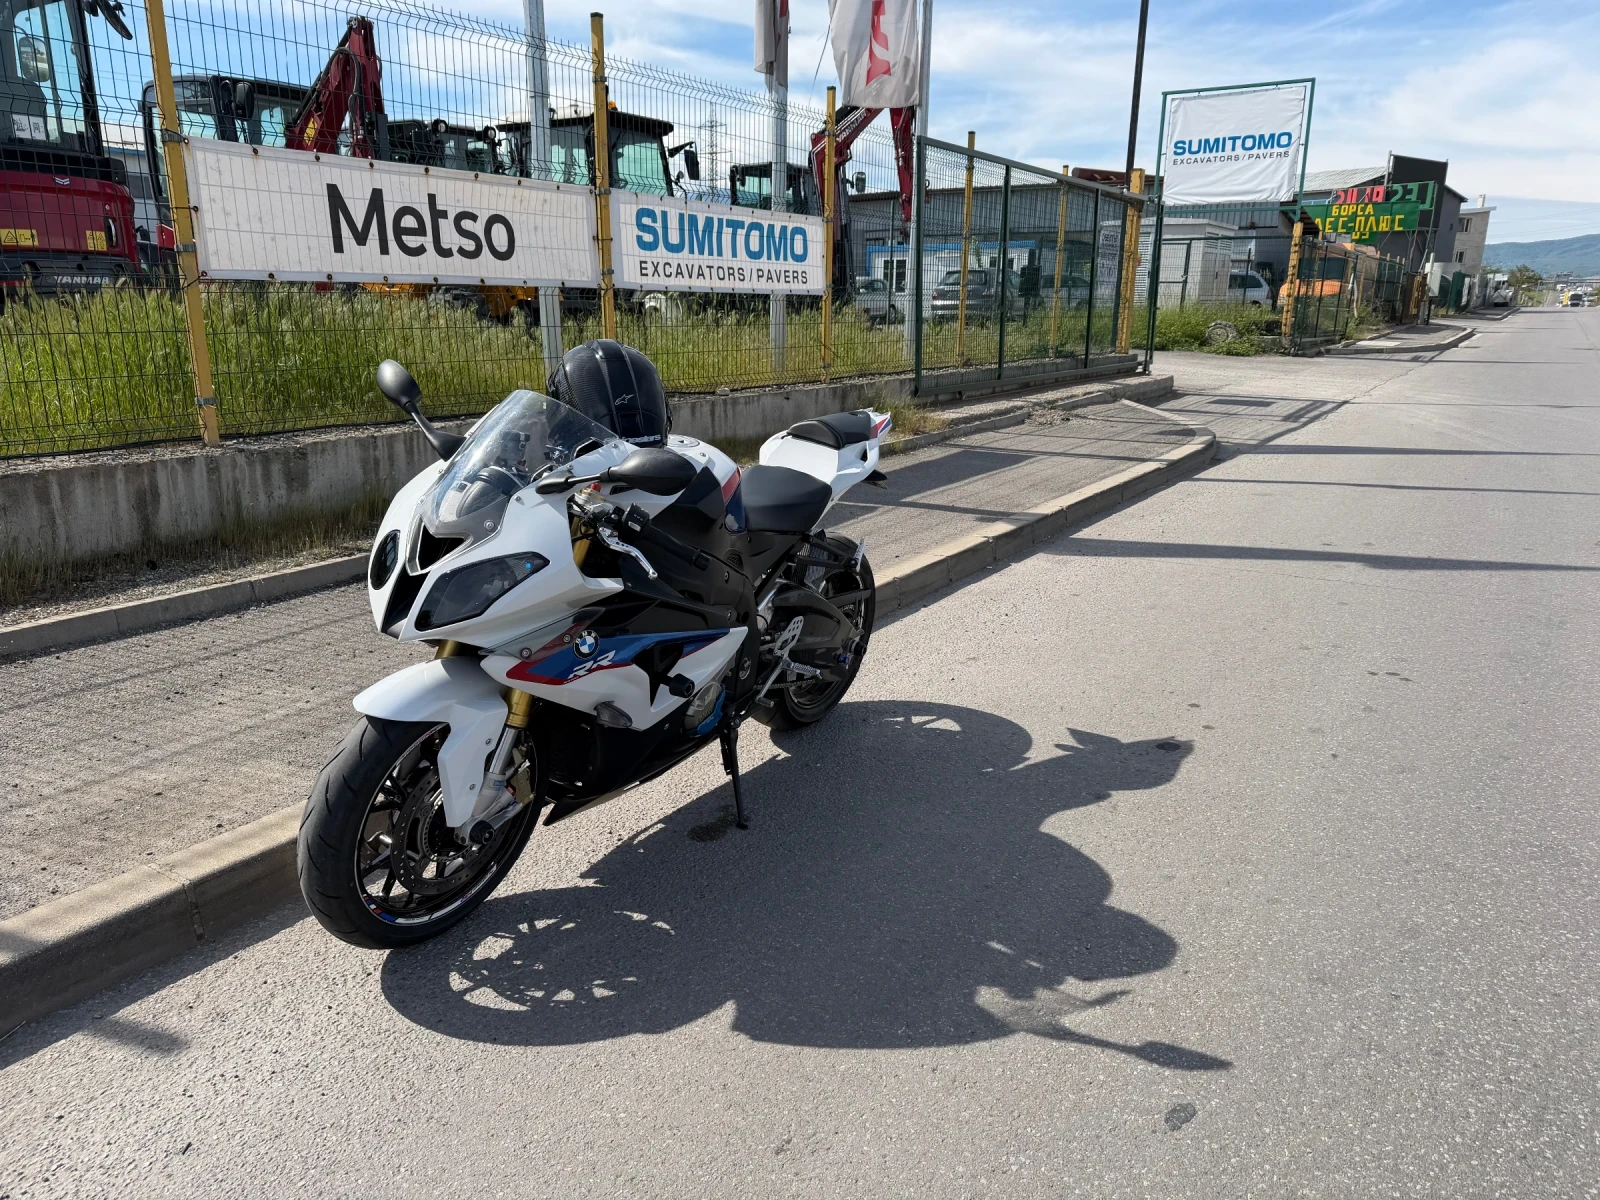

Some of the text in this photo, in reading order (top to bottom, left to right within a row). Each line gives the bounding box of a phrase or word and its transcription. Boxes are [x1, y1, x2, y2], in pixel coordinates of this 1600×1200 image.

[1173, 131, 1293, 156] SUMITOMO
[326, 183, 515, 261] Metso
[1332, 203, 1374, 216] БОРСА
[635, 207, 808, 263] SUMITOMO
[54, 275, 109, 285] YANMAR
